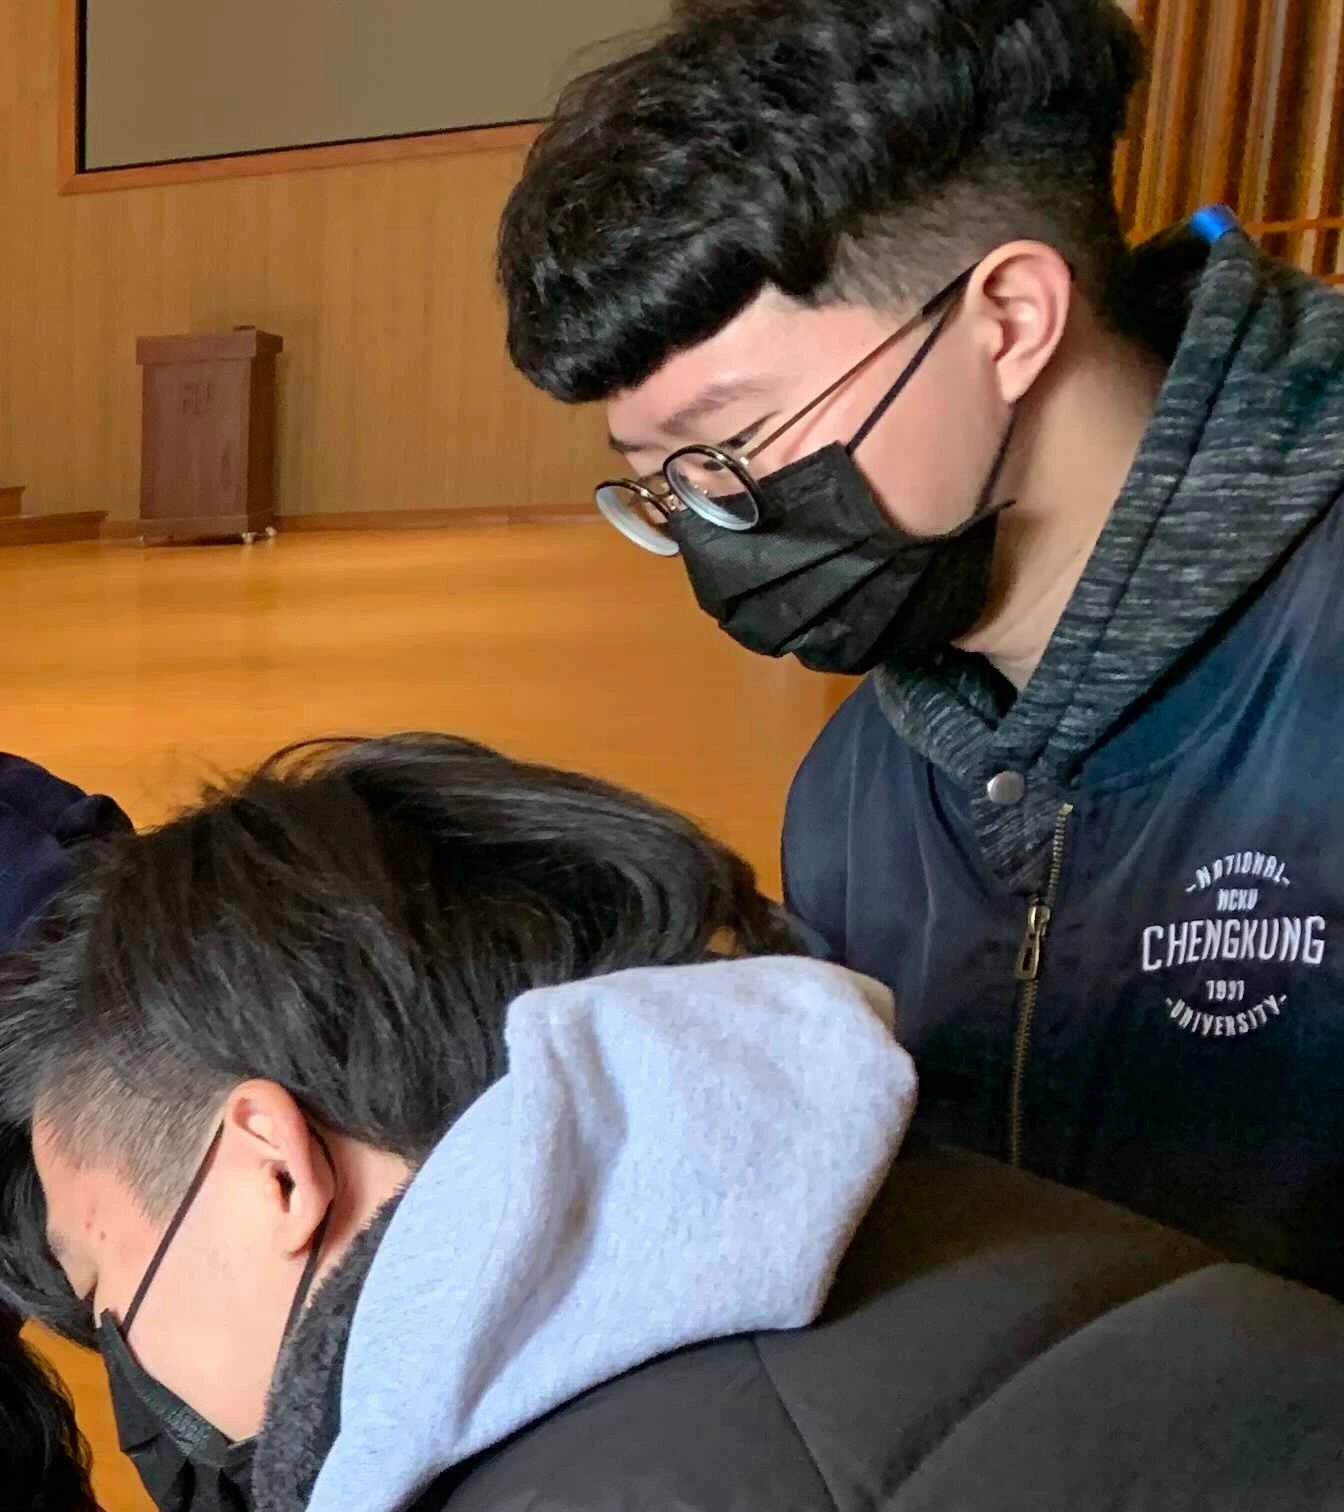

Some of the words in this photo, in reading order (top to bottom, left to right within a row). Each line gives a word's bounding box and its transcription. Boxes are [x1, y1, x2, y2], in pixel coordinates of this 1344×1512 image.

[1195, 851, 1286, 889] NATIONAL
[1216, 888, 1259, 912] NCKU
[1141, 915, 1326, 972] CHENGKUNG
[1169, 994, 1281, 1037] UNIVERSITY
